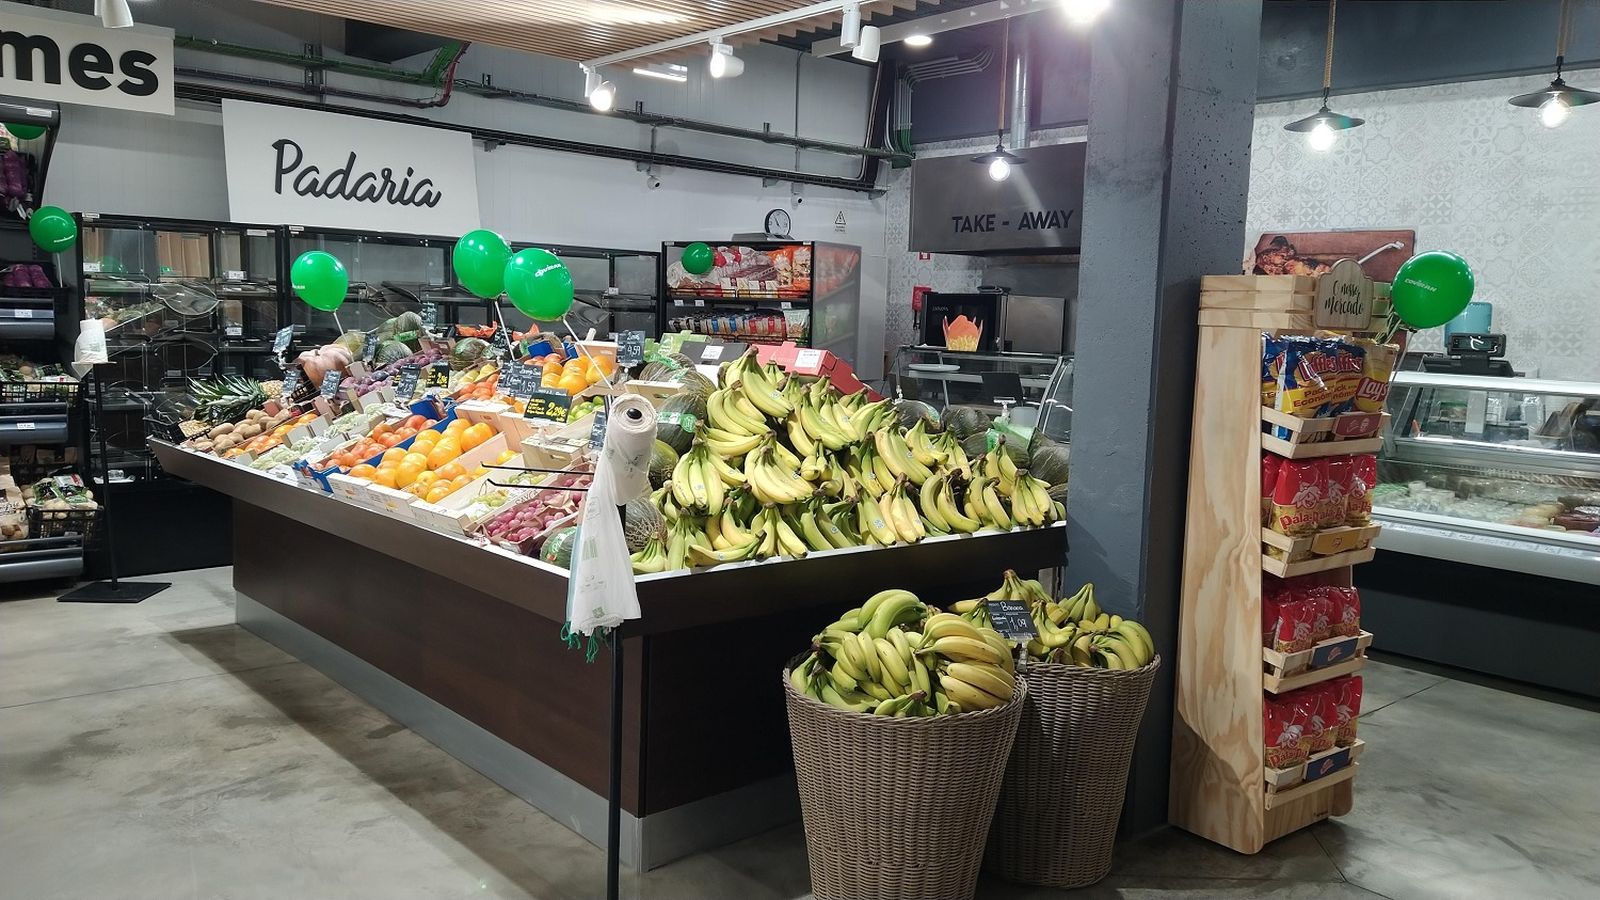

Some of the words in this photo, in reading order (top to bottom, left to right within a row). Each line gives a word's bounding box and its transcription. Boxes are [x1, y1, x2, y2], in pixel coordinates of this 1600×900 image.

[272, 138, 442, 208] Padaria
[952, 214, 996, 233] TAKE
[1018, 209, 1074, 231] AWAY
